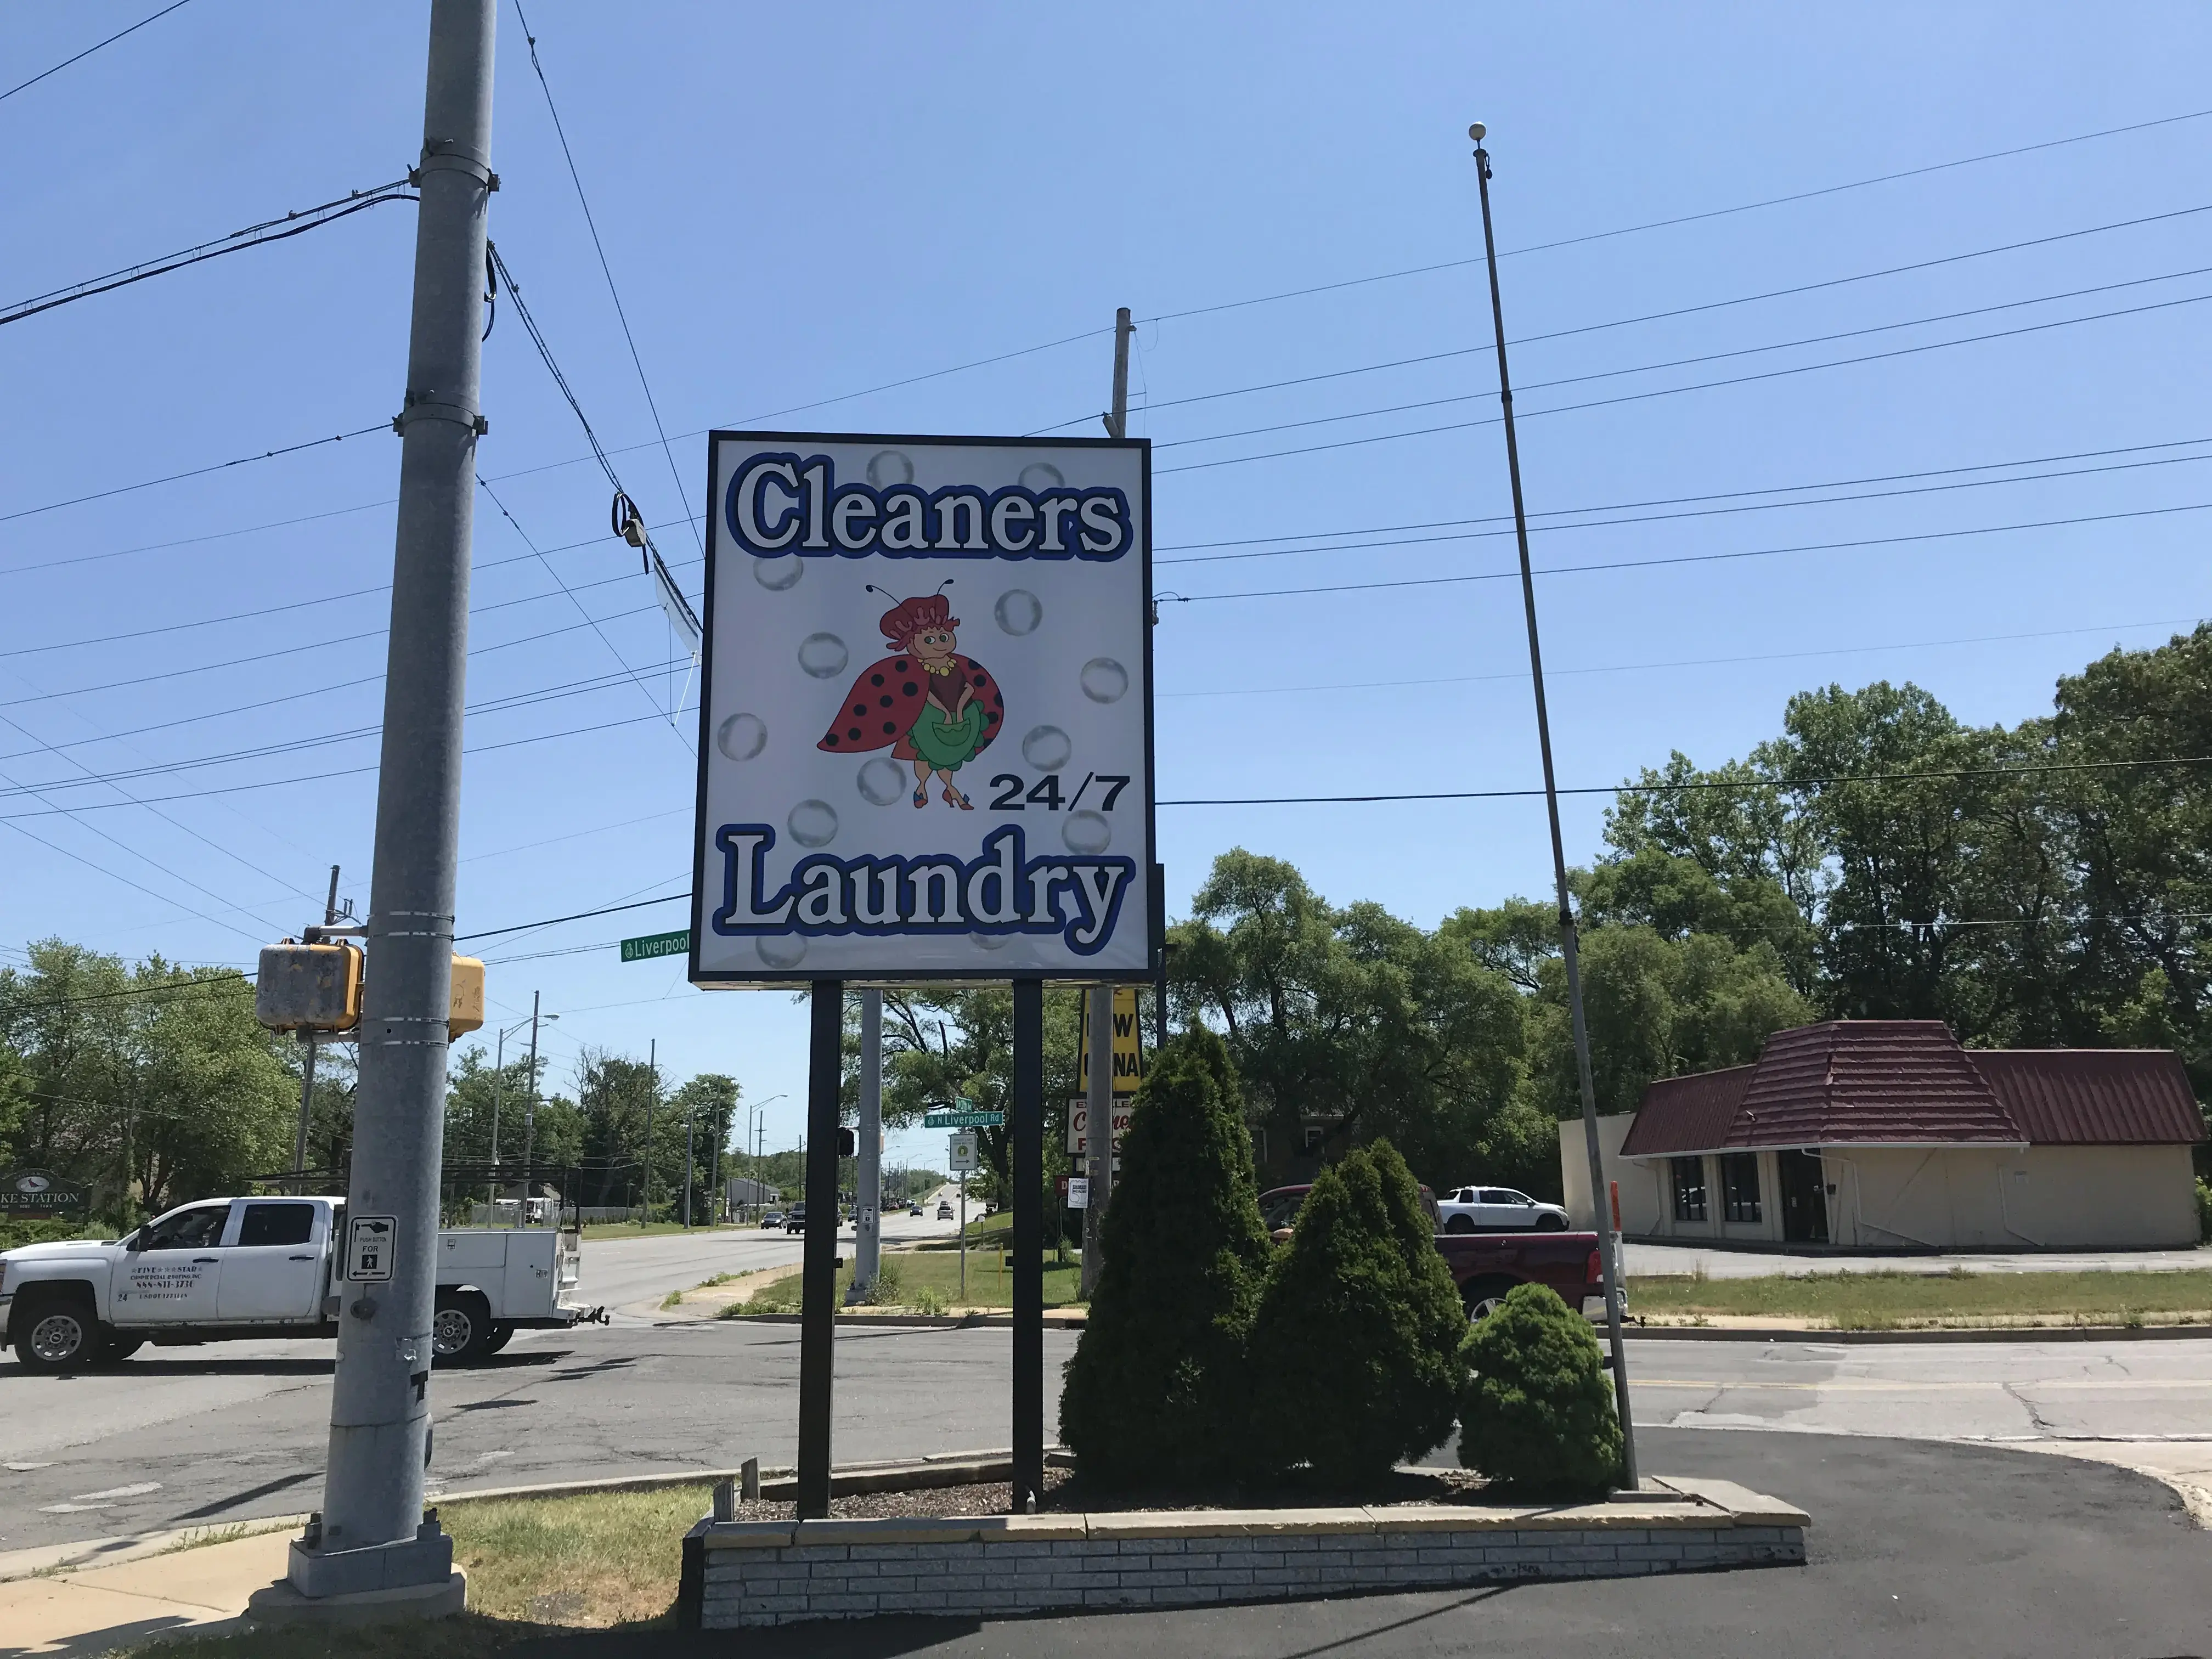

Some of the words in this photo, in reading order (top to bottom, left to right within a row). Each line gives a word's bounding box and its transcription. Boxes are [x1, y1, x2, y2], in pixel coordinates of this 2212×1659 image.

[734, 461, 1125, 554] Cleaners
[989, 771, 1131, 812] 24/7
[723, 833, 1129, 945] Laundry
[635, 933, 690, 957] Liverpool
[938, 1116, 943, 1125] N
[945, 1113, 988, 1125] Liverpool
[990, 1114, 999, 1122] Rd
[21, 1193, 79, 1203] STATION
[117, 1294, 127, 1302] 24
